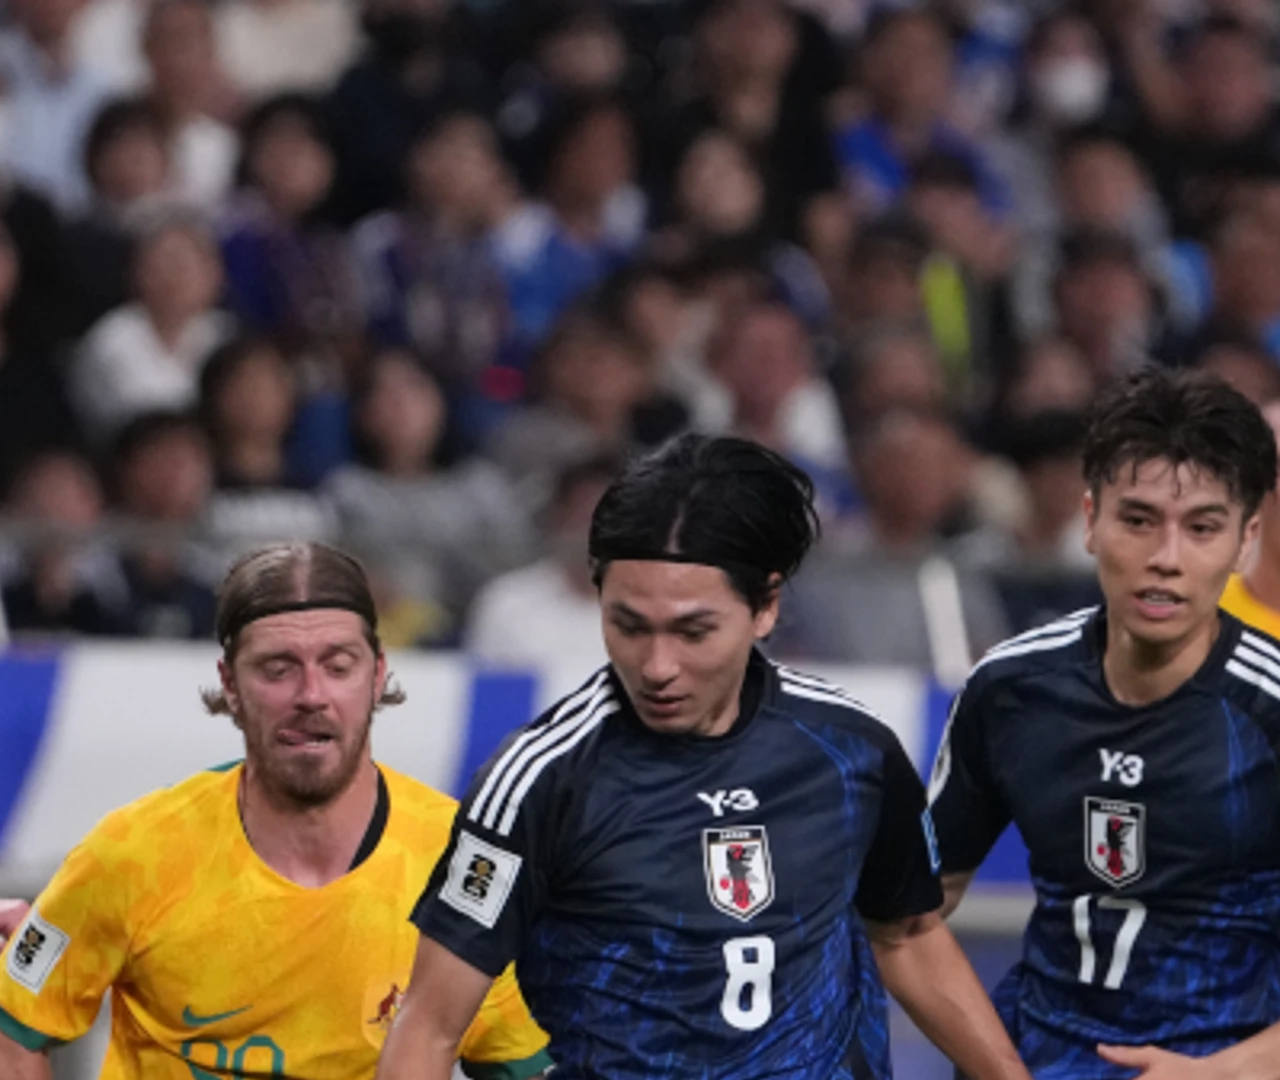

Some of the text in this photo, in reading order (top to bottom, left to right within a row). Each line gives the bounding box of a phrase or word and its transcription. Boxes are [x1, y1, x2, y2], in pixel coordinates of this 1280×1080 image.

[1098, 747, 1145, 788] Y-3
[696, 787, 760, 817] Y-3
[1073, 894, 1148, 989] 17
[720, 936, 775, 1031] 8
